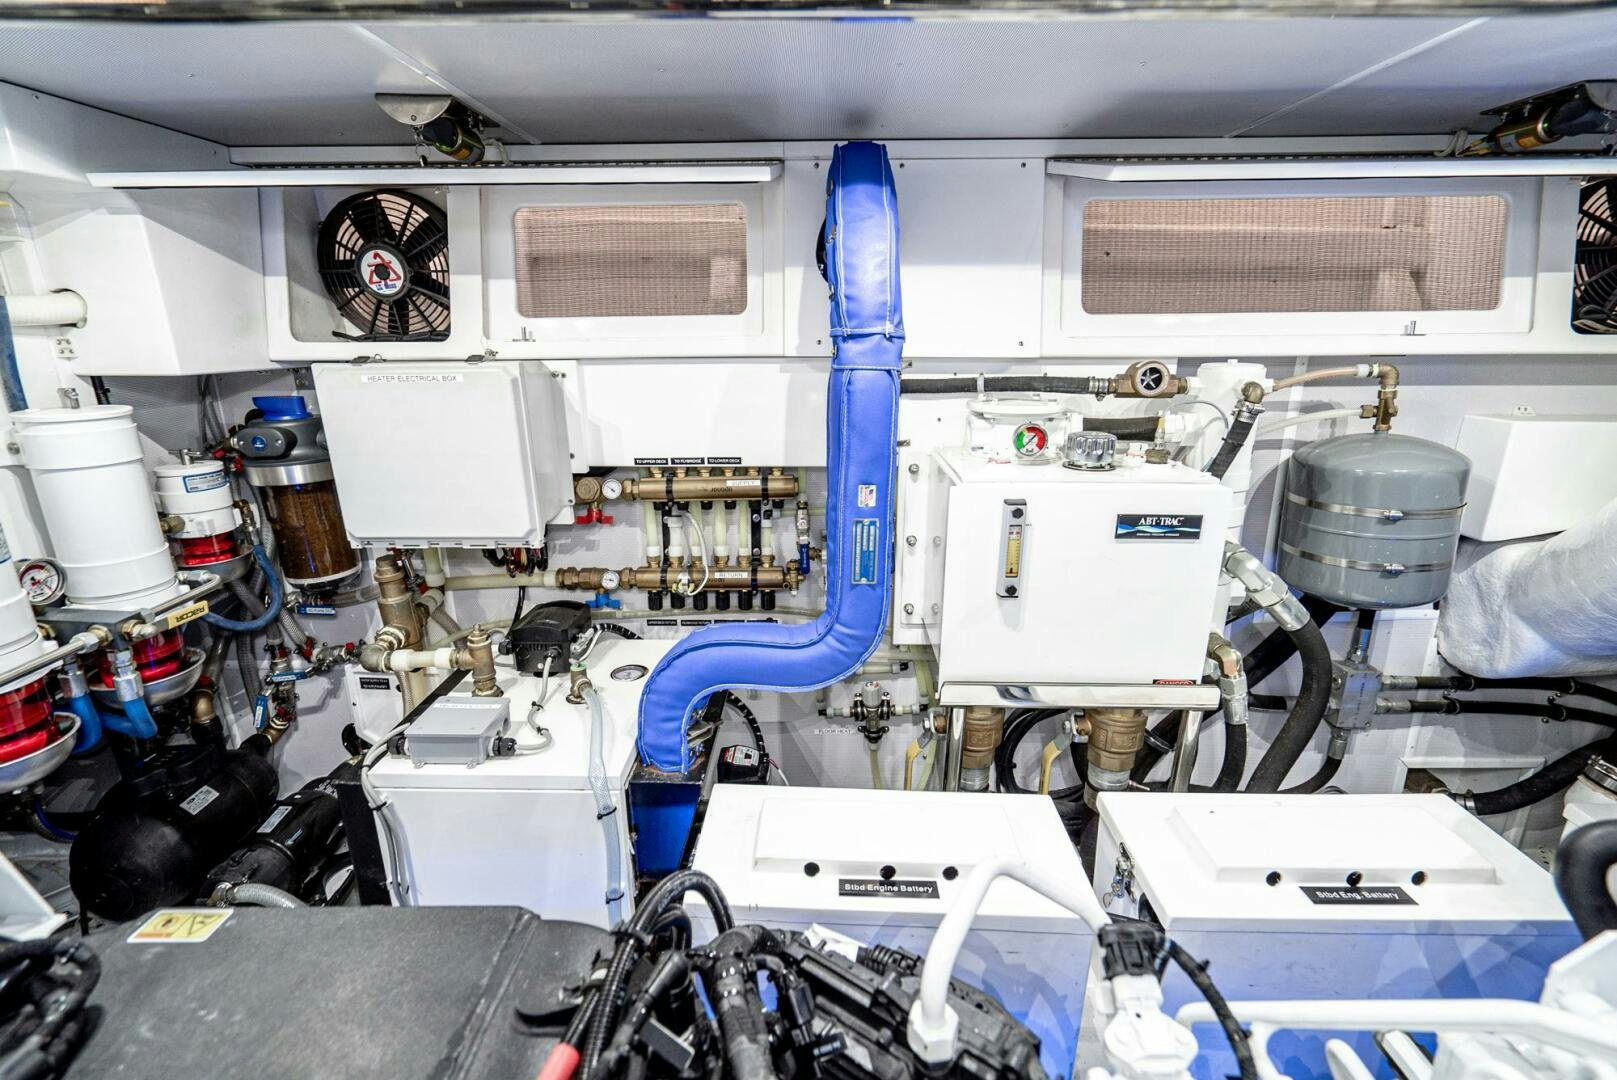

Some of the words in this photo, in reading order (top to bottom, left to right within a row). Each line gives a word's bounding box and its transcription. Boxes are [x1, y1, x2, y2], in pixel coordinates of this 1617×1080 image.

[1138, 517, 1183, 526] ABT-TRAC
[844, 883, 865, 891] Stbd
[867, 884, 899, 892] Engine
[900, 885, 933, 893] Battery
[1339, 891, 1363, 900] Eng.
[1362, 891, 1400, 900] Battery
